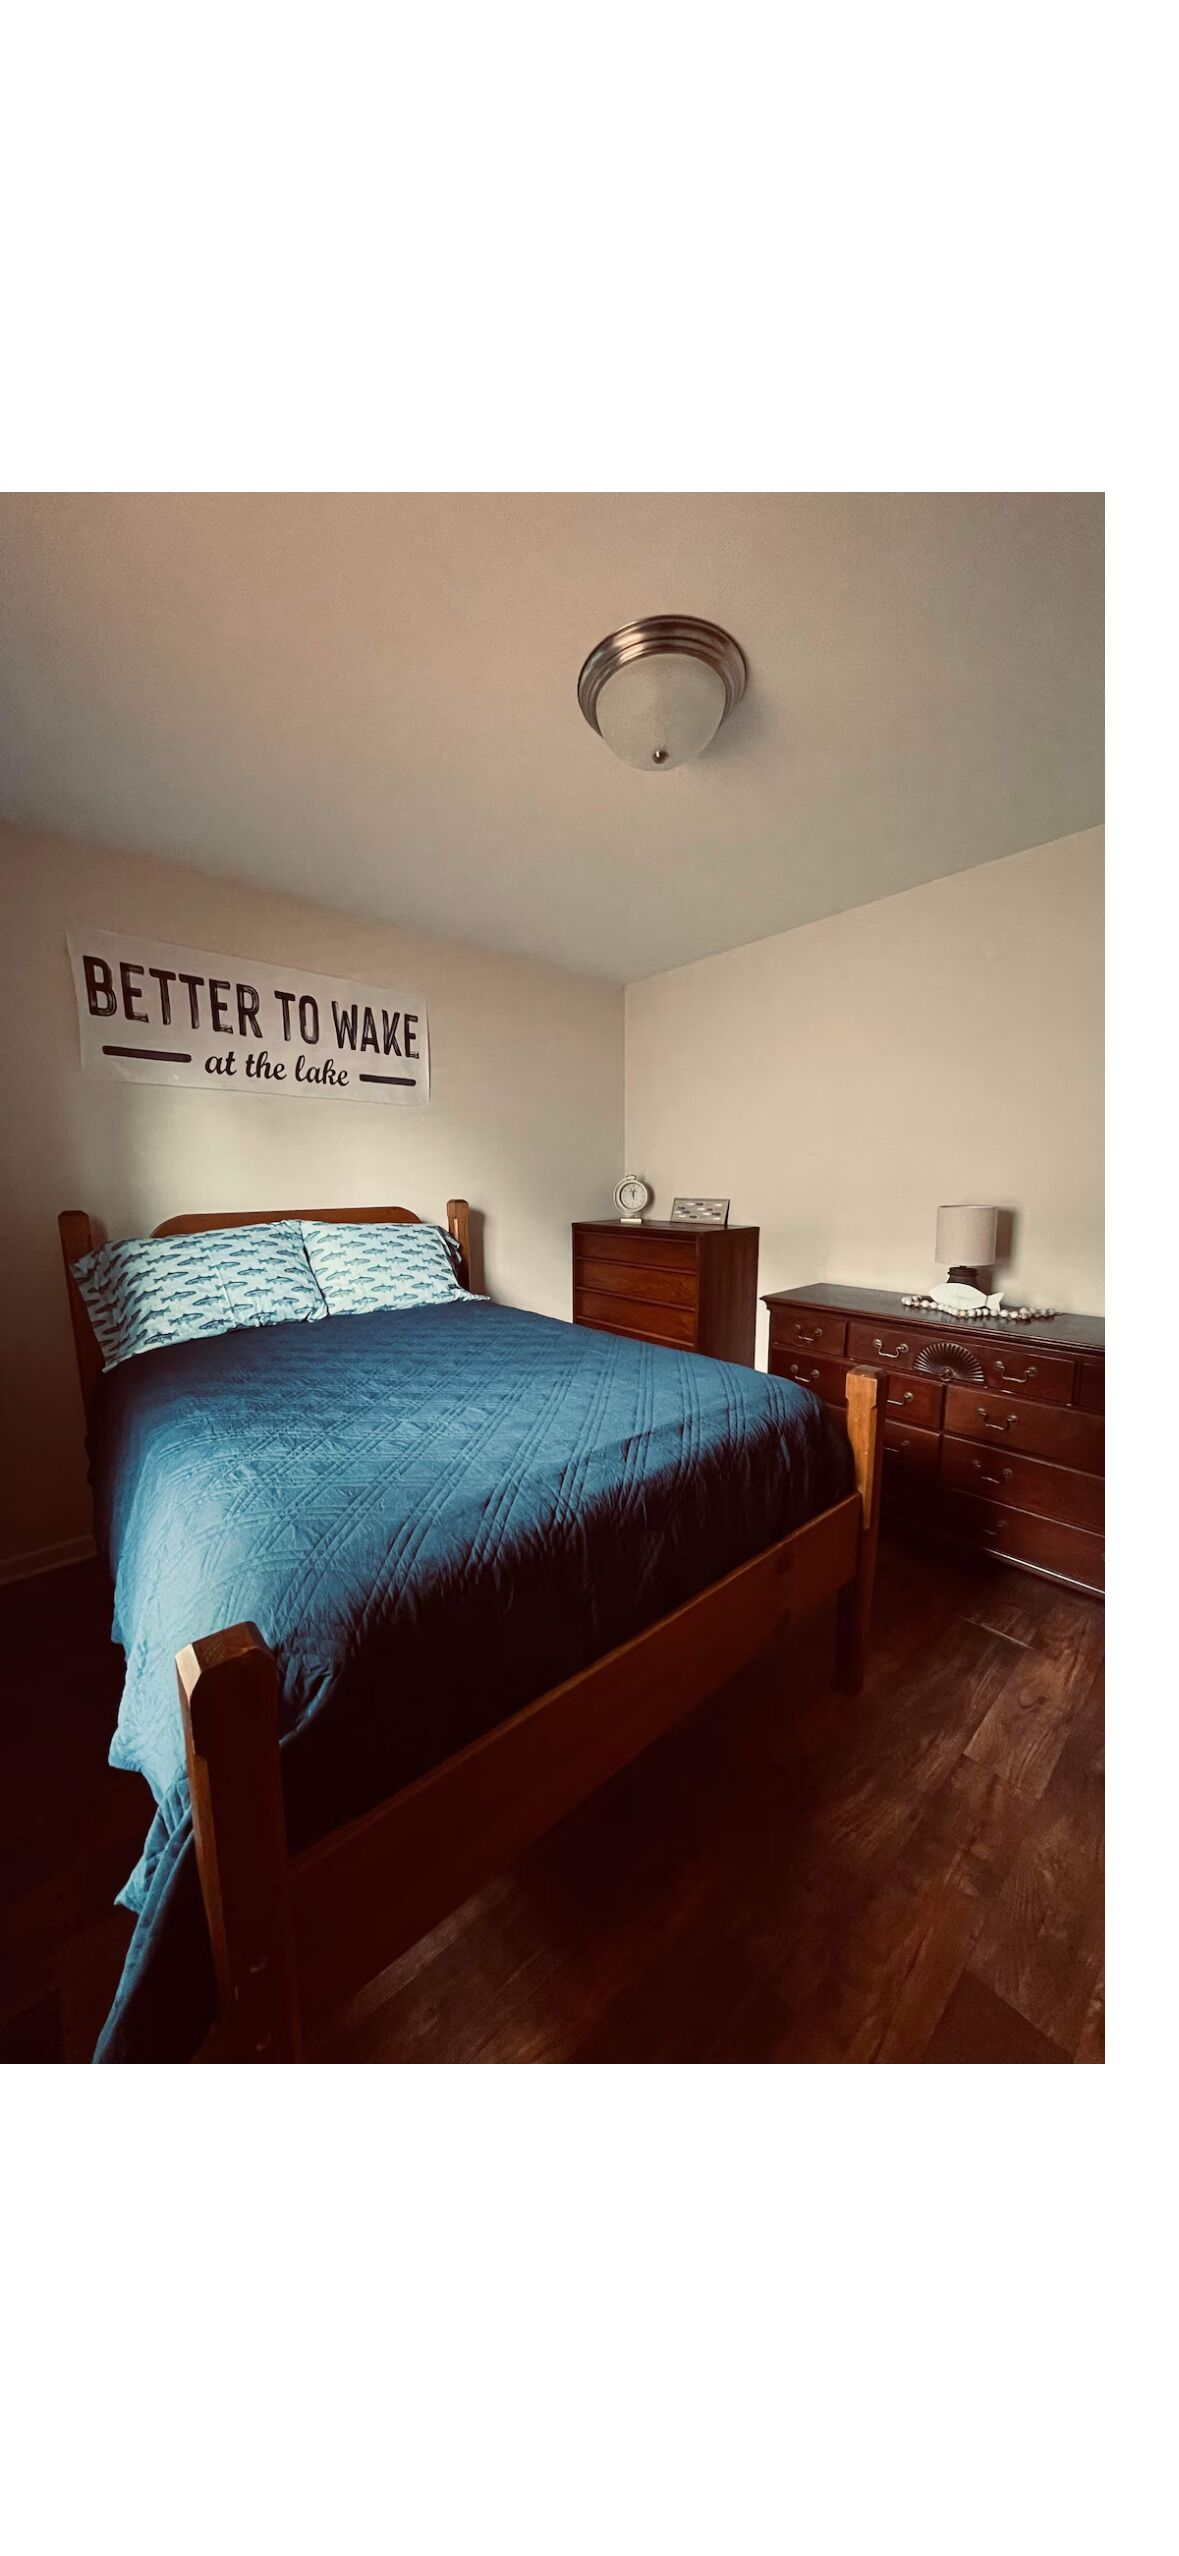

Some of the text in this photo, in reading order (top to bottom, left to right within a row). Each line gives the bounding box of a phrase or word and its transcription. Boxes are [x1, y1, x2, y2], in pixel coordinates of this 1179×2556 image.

[83, 955, 420, 1059] BETTER TO WAKE
[205, 1051, 350, 1086] at the lake
